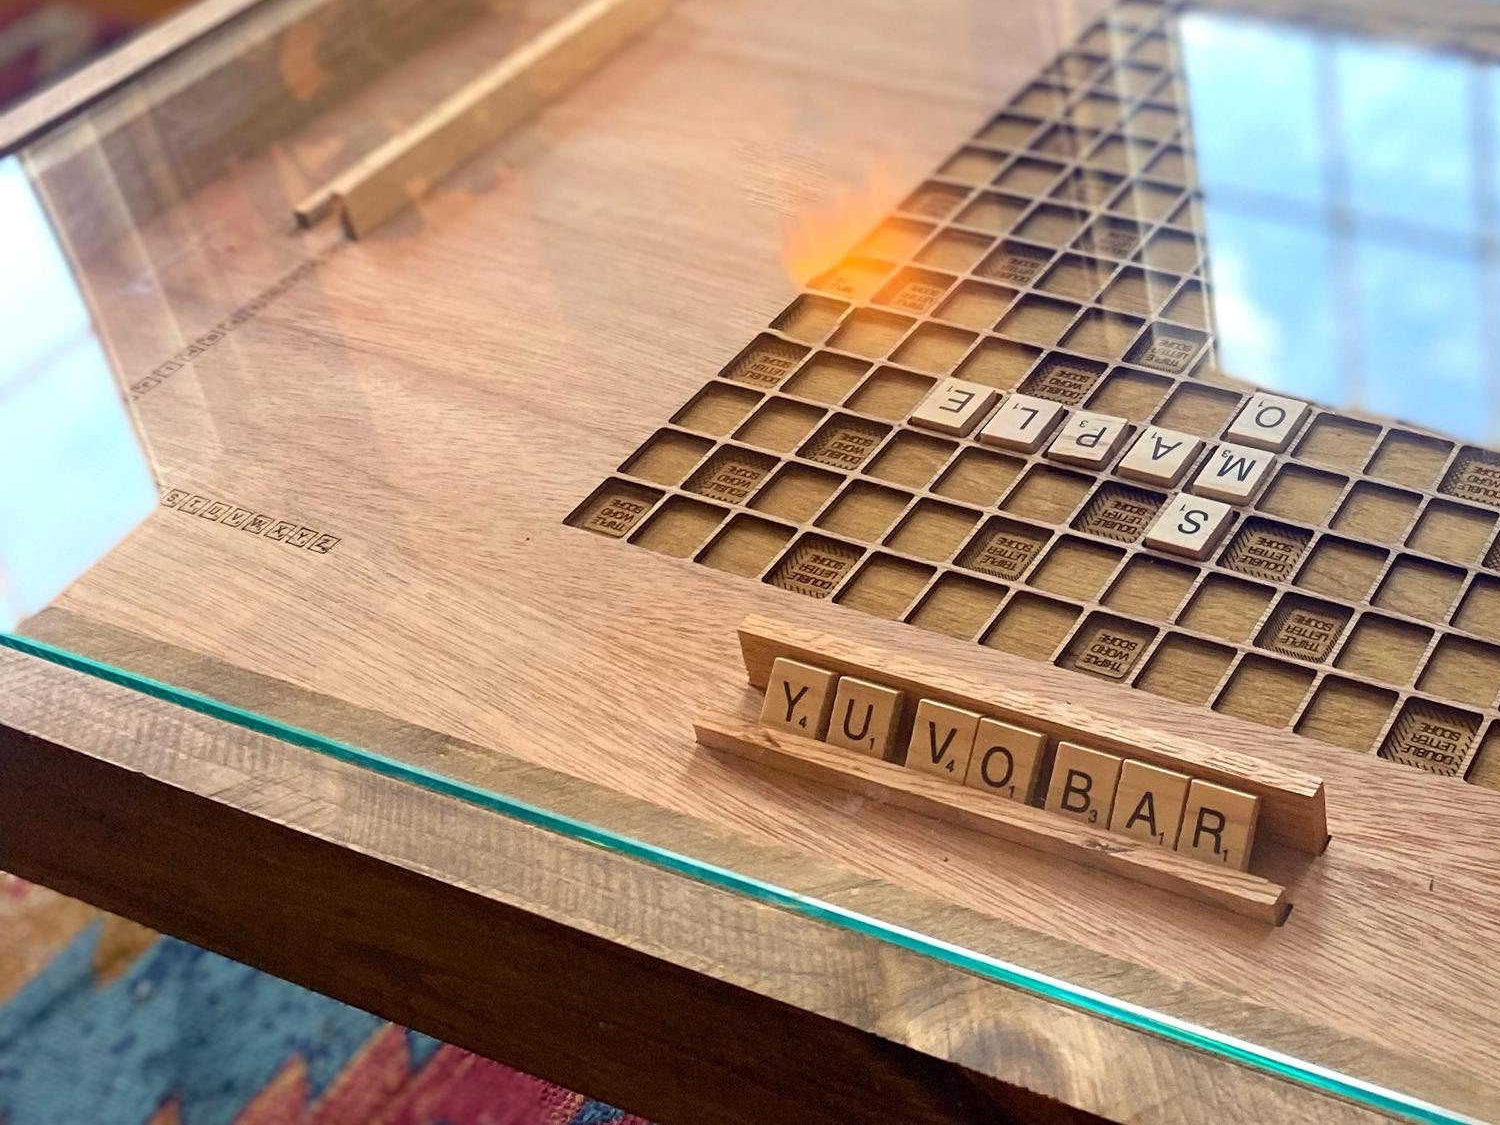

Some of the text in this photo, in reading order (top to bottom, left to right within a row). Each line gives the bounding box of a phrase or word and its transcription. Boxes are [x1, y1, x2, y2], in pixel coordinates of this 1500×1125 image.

[749, 362, 787, 376] LETTER
[757, 355, 793, 368] SCORE
[740, 369, 780, 384] DOUBLE
[1047, 377, 1083, 390] WORD
[1054, 369, 1090, 382] SCORE
[1036, 383, 1081, 399] DOUBLE
[829, 440, 866, 455] WORD
[836, 432, 874, 446] SCORE
[818, 447, 862, 464] DOUBLE
[598, 506, 637, 522] WORD
[607, 498, 645, 514] SCORE
[1108, 500, 1149, 516] SCORE
[589, 515, 628, 531] TRIPLE
[1100, 508, 1143, 525] LETTER
[1090, 516, 1138, 535] DOUBLE
[985, 544, 1029, 561] LETTER
[994, 536, 1035, 552] SCORE
[1252, 536, 1295, 553] SCORE
[806, 553, 847, 570] SCORE
[978, 554, 1020, 570] TRIPLE
[1245, 545, 1289, 562] LETTER
[797, 562, 839, 579] LETTER
[1235, 553, 1286, 572] DOUBLE
[786, 571, 833, 589] DOUBLE
[1290, 613, 1335, 632] SCORE
[1095, 632, 1138, 650] SCORE
[1283, 623, 1330, 642] LETTER
[1088, 642, 1132, 661] WORD
[1277, 634, 1322, 652] TRIPLE
[1081, 653, 1125, 671] TRIPLE
[1416, 721, 1461, 741] SCORE
[1408, 732, 1458, 753] LETTER
[1399, 742, 1455, 765] DOUBLE
